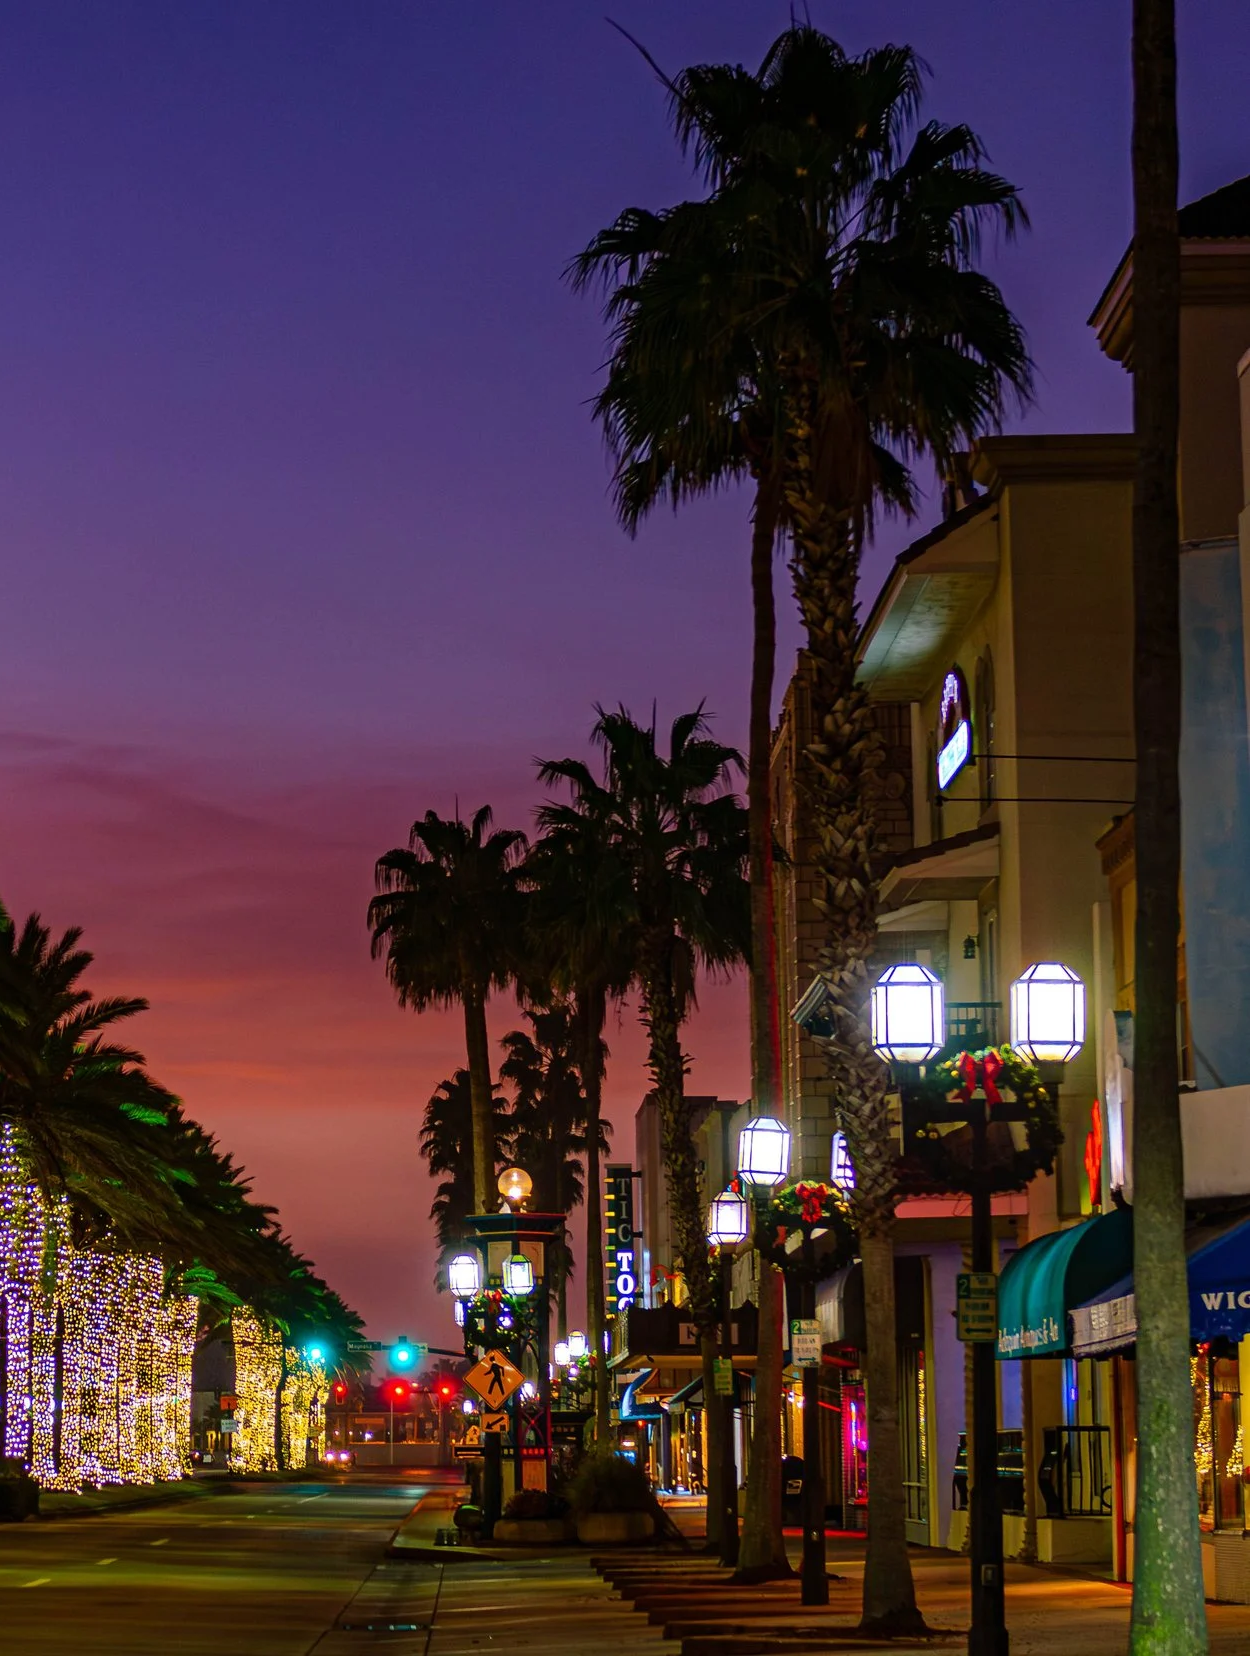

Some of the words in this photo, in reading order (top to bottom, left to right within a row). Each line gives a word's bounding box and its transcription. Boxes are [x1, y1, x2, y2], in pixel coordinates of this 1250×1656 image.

[616, 1178, 631, 1243] TIC
[959, 1278, 968, 1295] 2
[792, 1321, 800, 1333] 2
